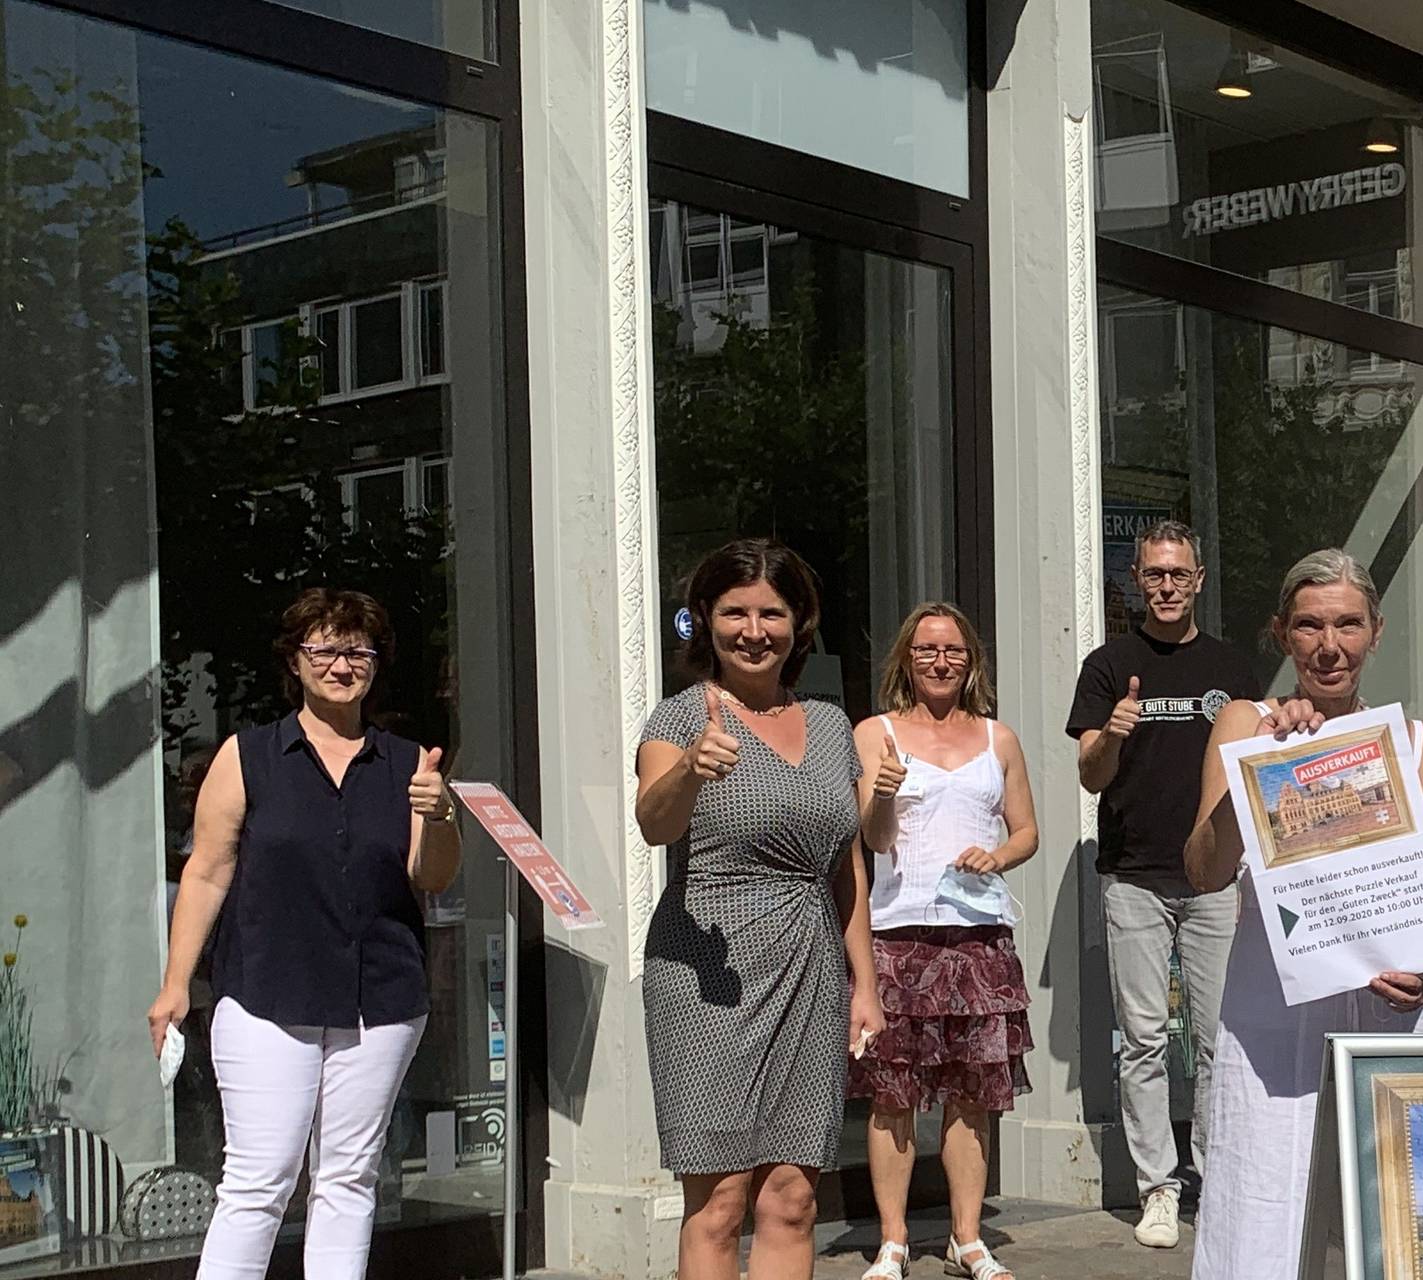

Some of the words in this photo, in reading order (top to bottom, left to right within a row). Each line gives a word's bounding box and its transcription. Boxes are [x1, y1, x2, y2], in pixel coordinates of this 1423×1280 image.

[1146, 700, 1167, 712] GUTE
[1168, 700, 1194, 712] STUBE
[1300, 745, 1376, 781] AUSVERKAUFT
[1273, 885, 1287, 895] Für
[1289, 878, 1314, 891] heute
[1316, 872, 1342, 884] leider
[1344, 865, 1369, 878] schon
[1371, 850, 1423, 871] ausverkauft!
[1301, 896, 1317, 907] Der
[1319, 888, 1353, 903] nächste
[1355, 880, 1384, 892] Puzzle
[1384, 870, 1418, 886] Verkauf
[1304, 909, 1317, 920] für
[1319, 904, 1336, 916] den
[1338, 896, 1369, 913] „Guten
[1308, 922, 1322, 932] am
[1323, 910, 1373, 928] 12.09.2020
[1374, 906, 1385, 916] ab
[1388, 900, 1411, 912] 10:00
[1288, 943, 1318, 957] Vielen
[1319, 936, 1342, 949] Dank
[1342, 933, 1356, 944] für
[1357, 930, 1370, 941] Ihr
